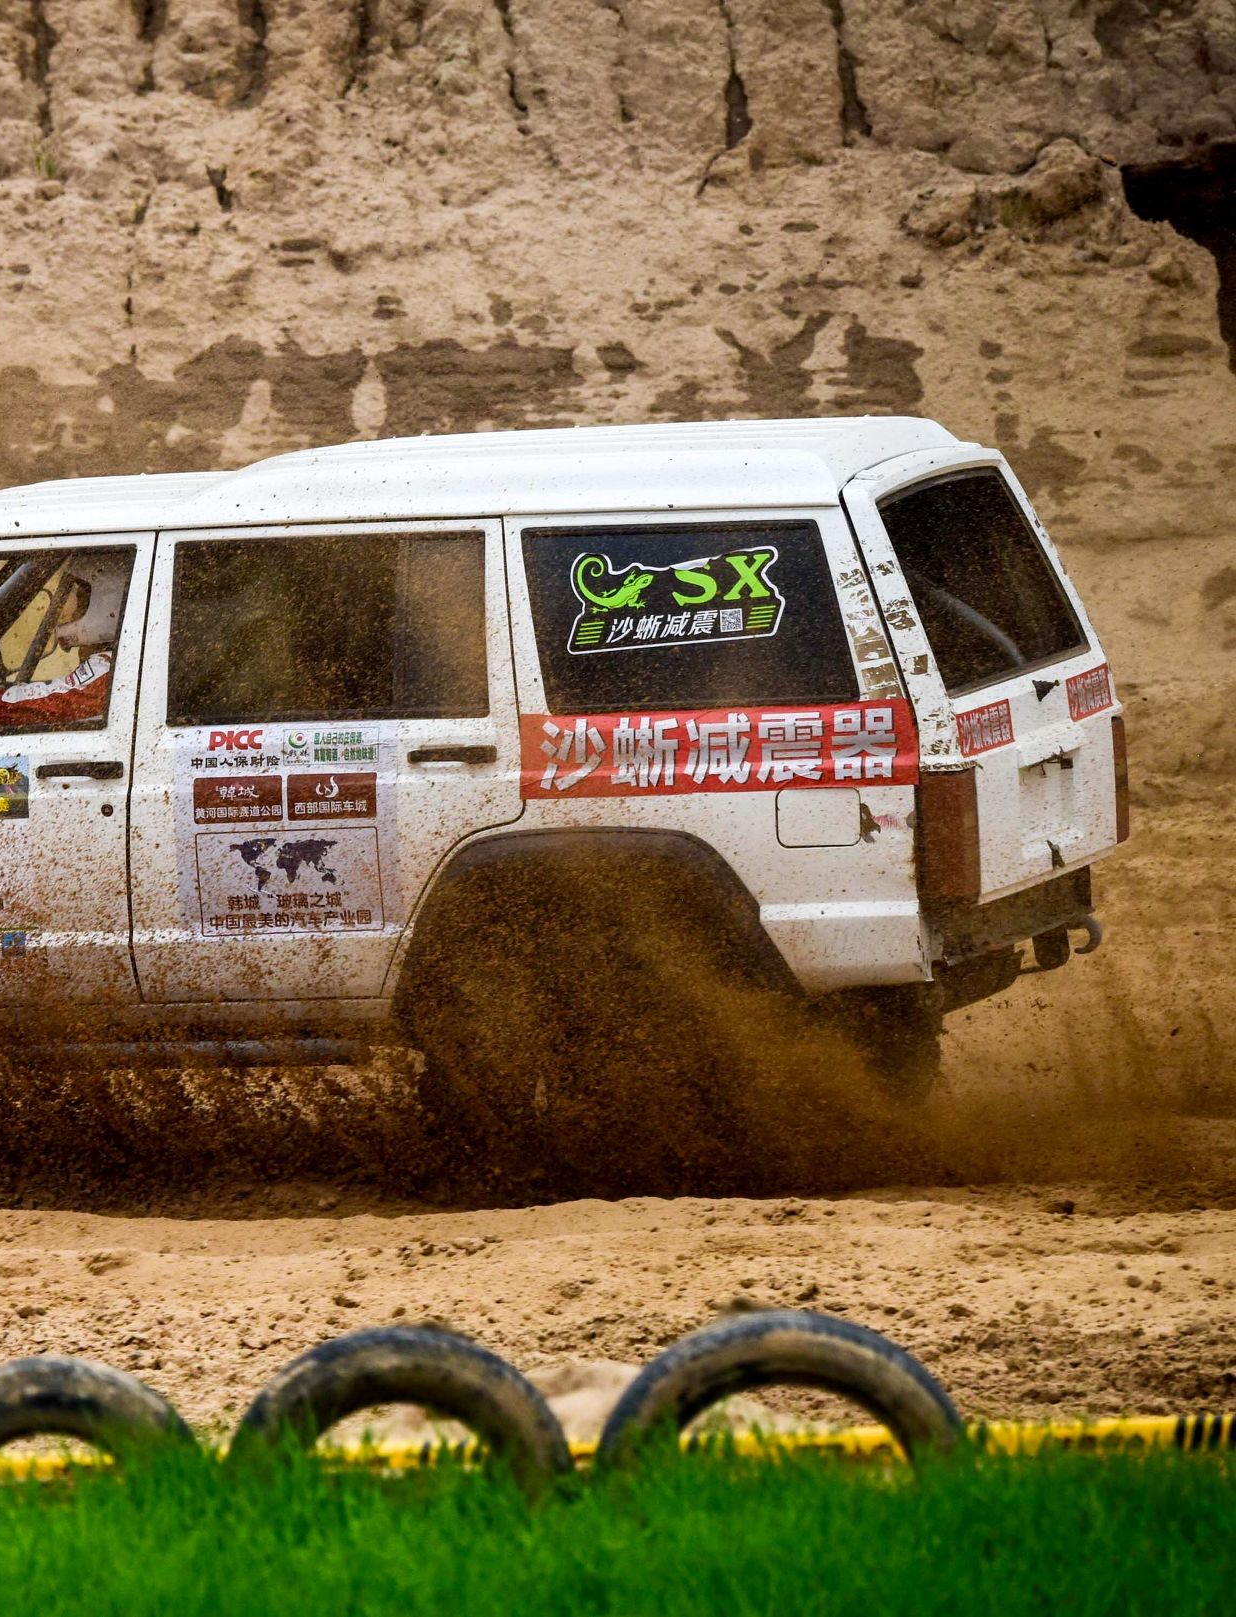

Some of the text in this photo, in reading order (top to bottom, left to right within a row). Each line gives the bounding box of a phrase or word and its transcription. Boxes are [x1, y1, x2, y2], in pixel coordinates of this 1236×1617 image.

[672, 553, 771, 607] SX
[606, 609, 718, 644] 沙蜥减震
[208, 730, 263, 751] PICC
[540, 708, 896, 791] 沙蜥减震器
[190, 753, 280, 769] 中国人保财险
[294, 801, 368, 815] 西部国际车城
